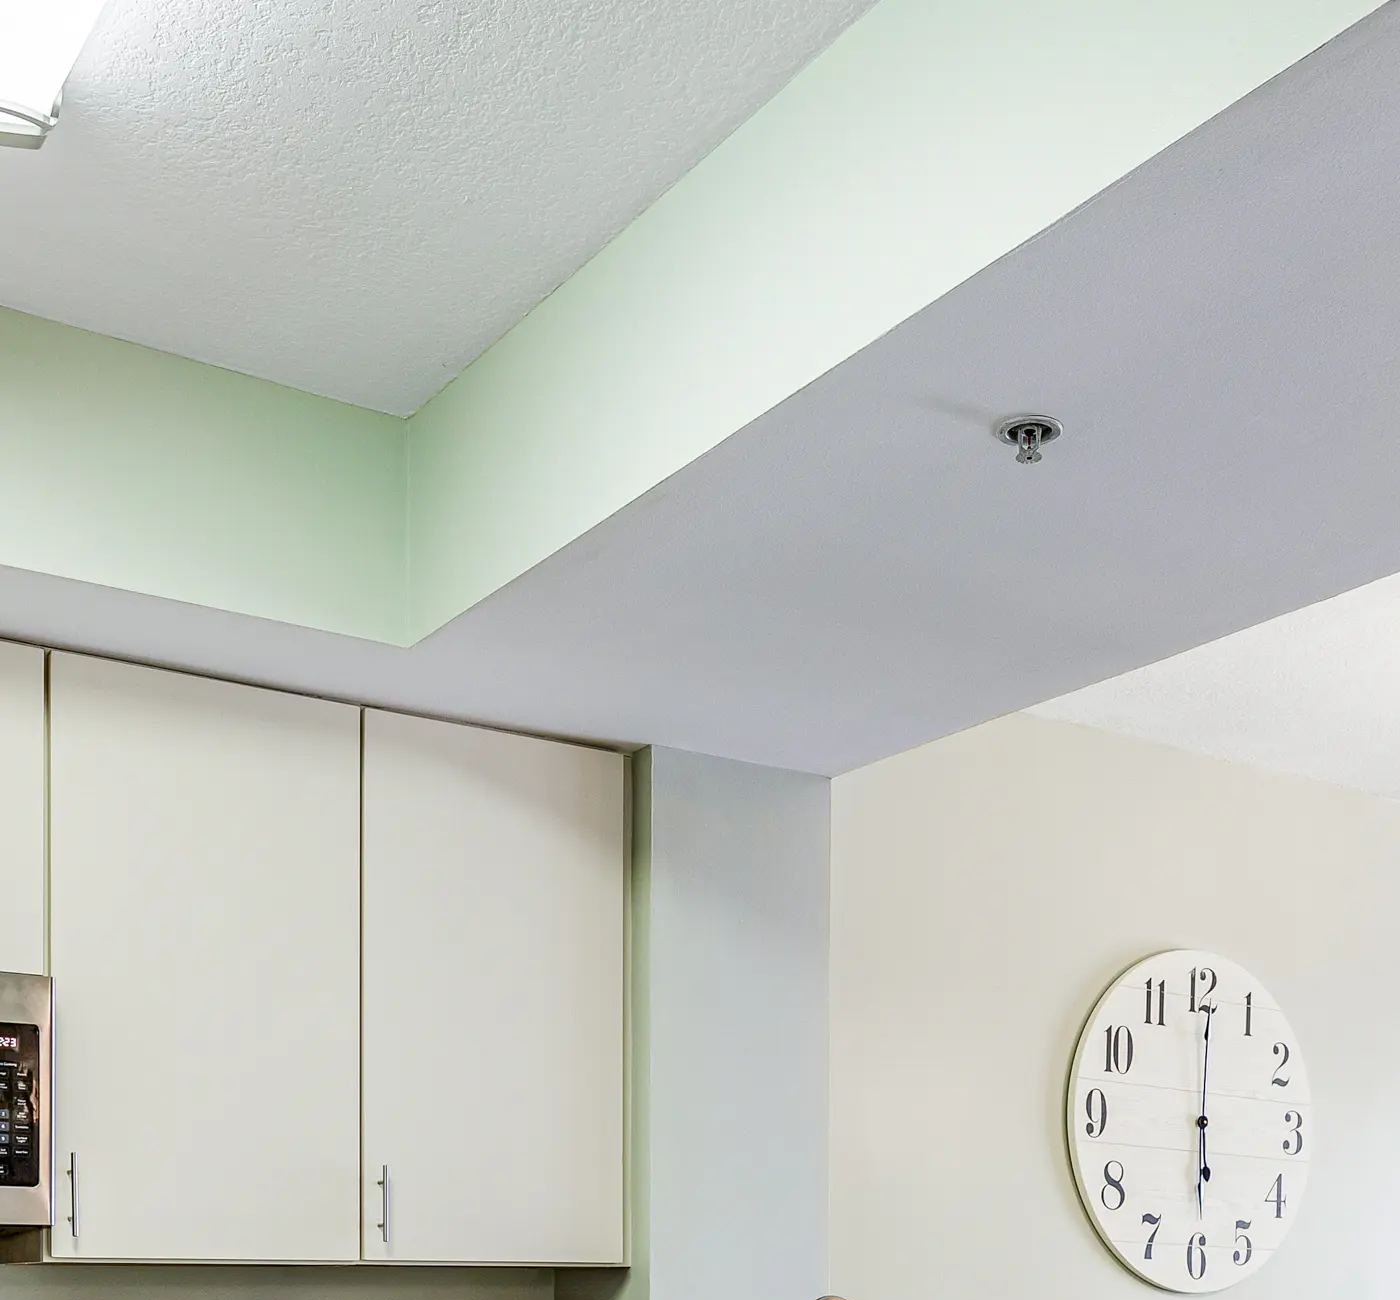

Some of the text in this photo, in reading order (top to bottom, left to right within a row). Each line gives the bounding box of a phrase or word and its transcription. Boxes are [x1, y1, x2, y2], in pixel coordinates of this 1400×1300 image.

[1144, 977, 1166, 1026] 11
[1188, 966, 1218, 1013] 12
[1243, 991, 1252, 1036] 1
[1103, 1024, 1134, 1075] 10
[1271, 1042, 1290, 1087] 2
[1085, 1087, 1107, 1138] 9
[1283, 1110, 1303, 1155] 3
[1101, 1160, 1126, 1211] 8
[1264, 1173, 1287, 1218] 4
[1142, 1213, 1162, 1259] 7
[1186, 1232, 1206, 1280] 6
[1233, 1219, 1252, 1266] 5
